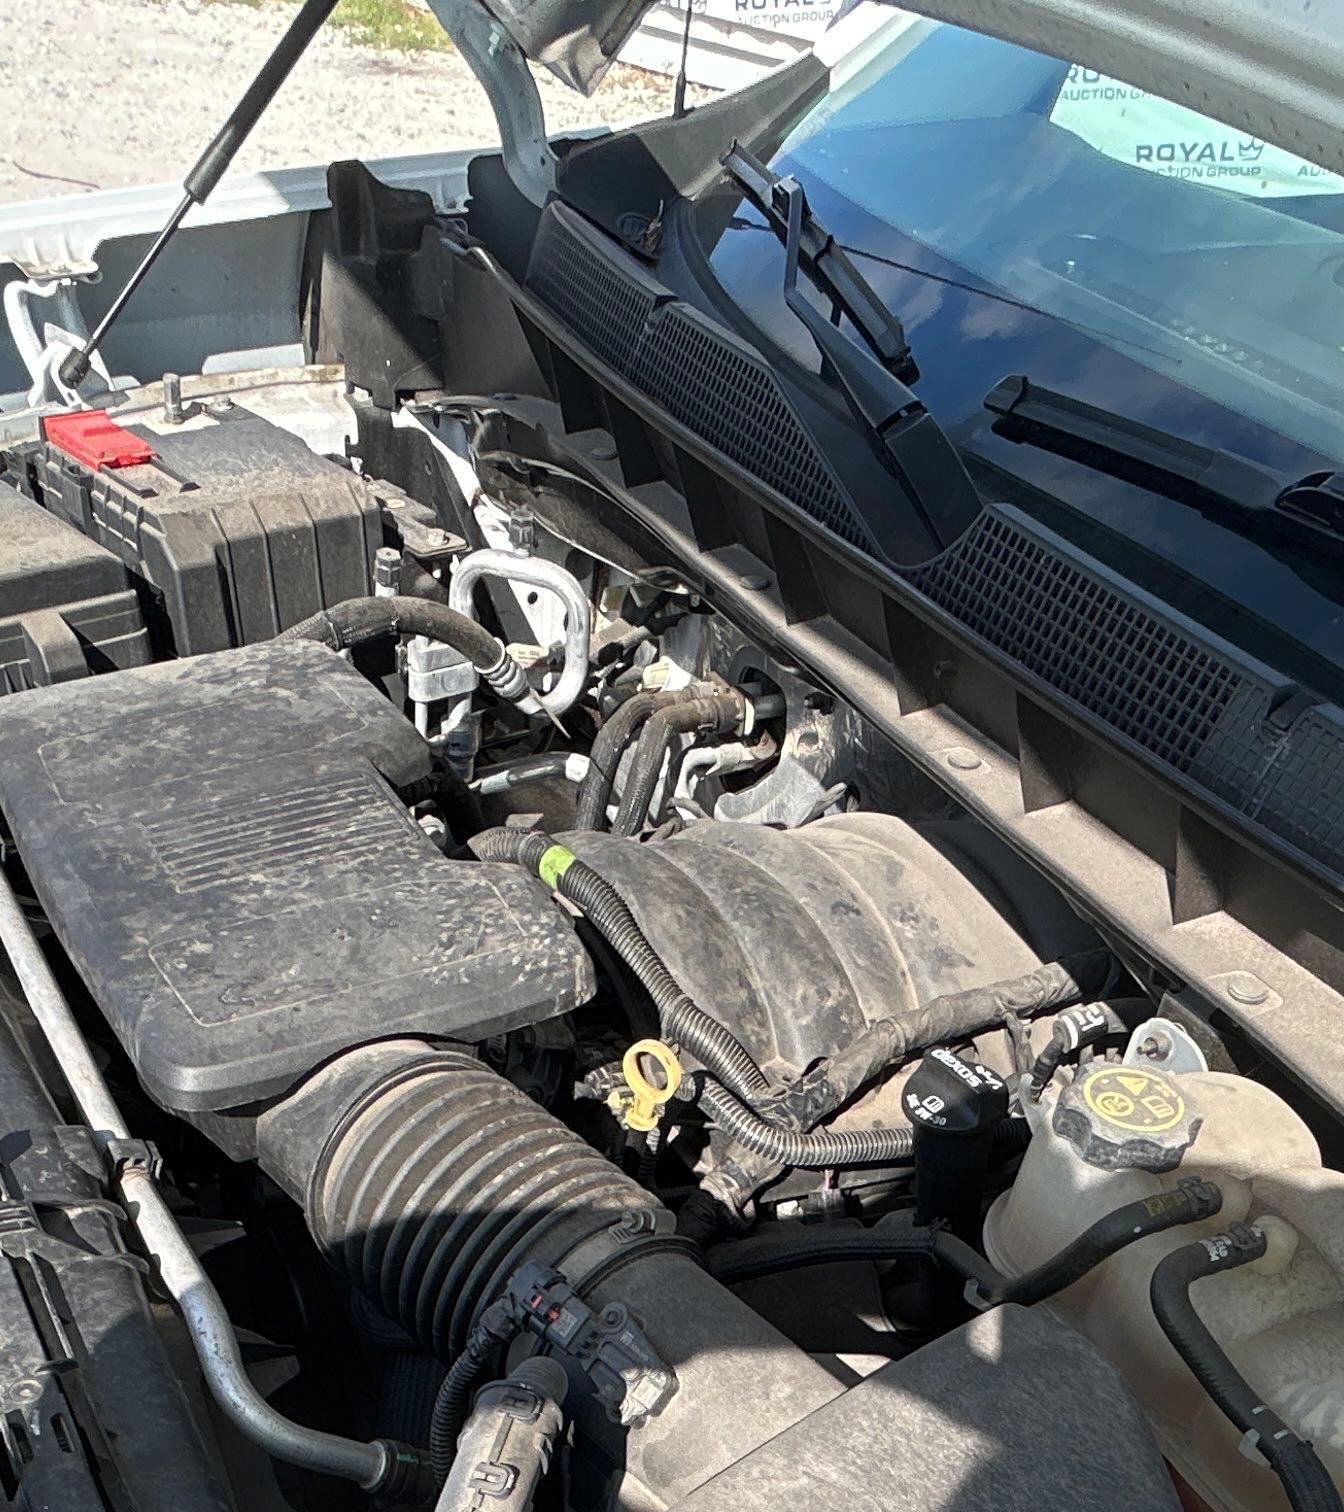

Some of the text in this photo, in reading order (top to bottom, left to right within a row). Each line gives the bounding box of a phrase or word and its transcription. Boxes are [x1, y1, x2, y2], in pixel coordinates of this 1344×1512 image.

[792, 10, 834, 22] GROUP
[1135, 141, 1235, 163] ROYAL
[1206, 165, 1262, 177] GROUP
[931, 1048, 983, 1088] dexos
